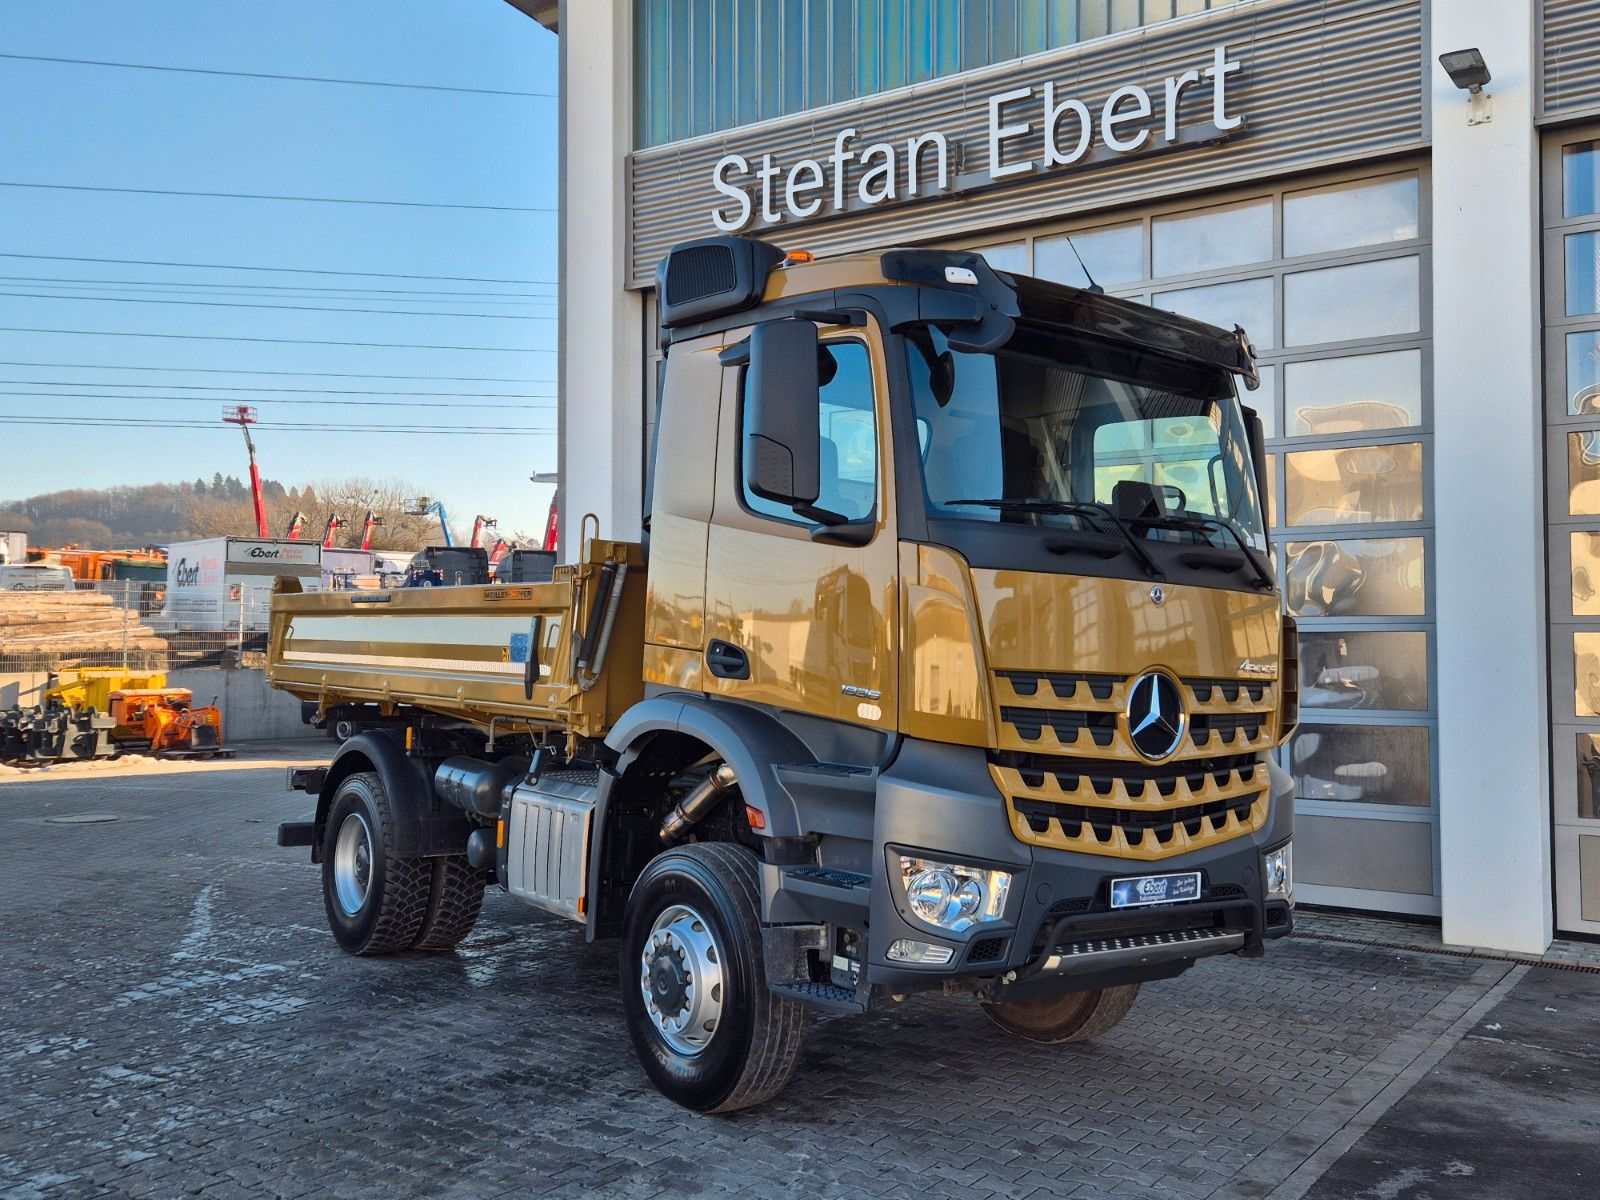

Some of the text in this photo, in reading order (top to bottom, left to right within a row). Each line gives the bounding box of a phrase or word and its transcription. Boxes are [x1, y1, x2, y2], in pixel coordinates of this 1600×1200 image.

[711, 46, 1243, 233] Stefan Ebert
[249, 547, 279, 559] Ebert
[176, 557, 199, 588] Ebert
[1143, 879, 1167, 894] Ebert
